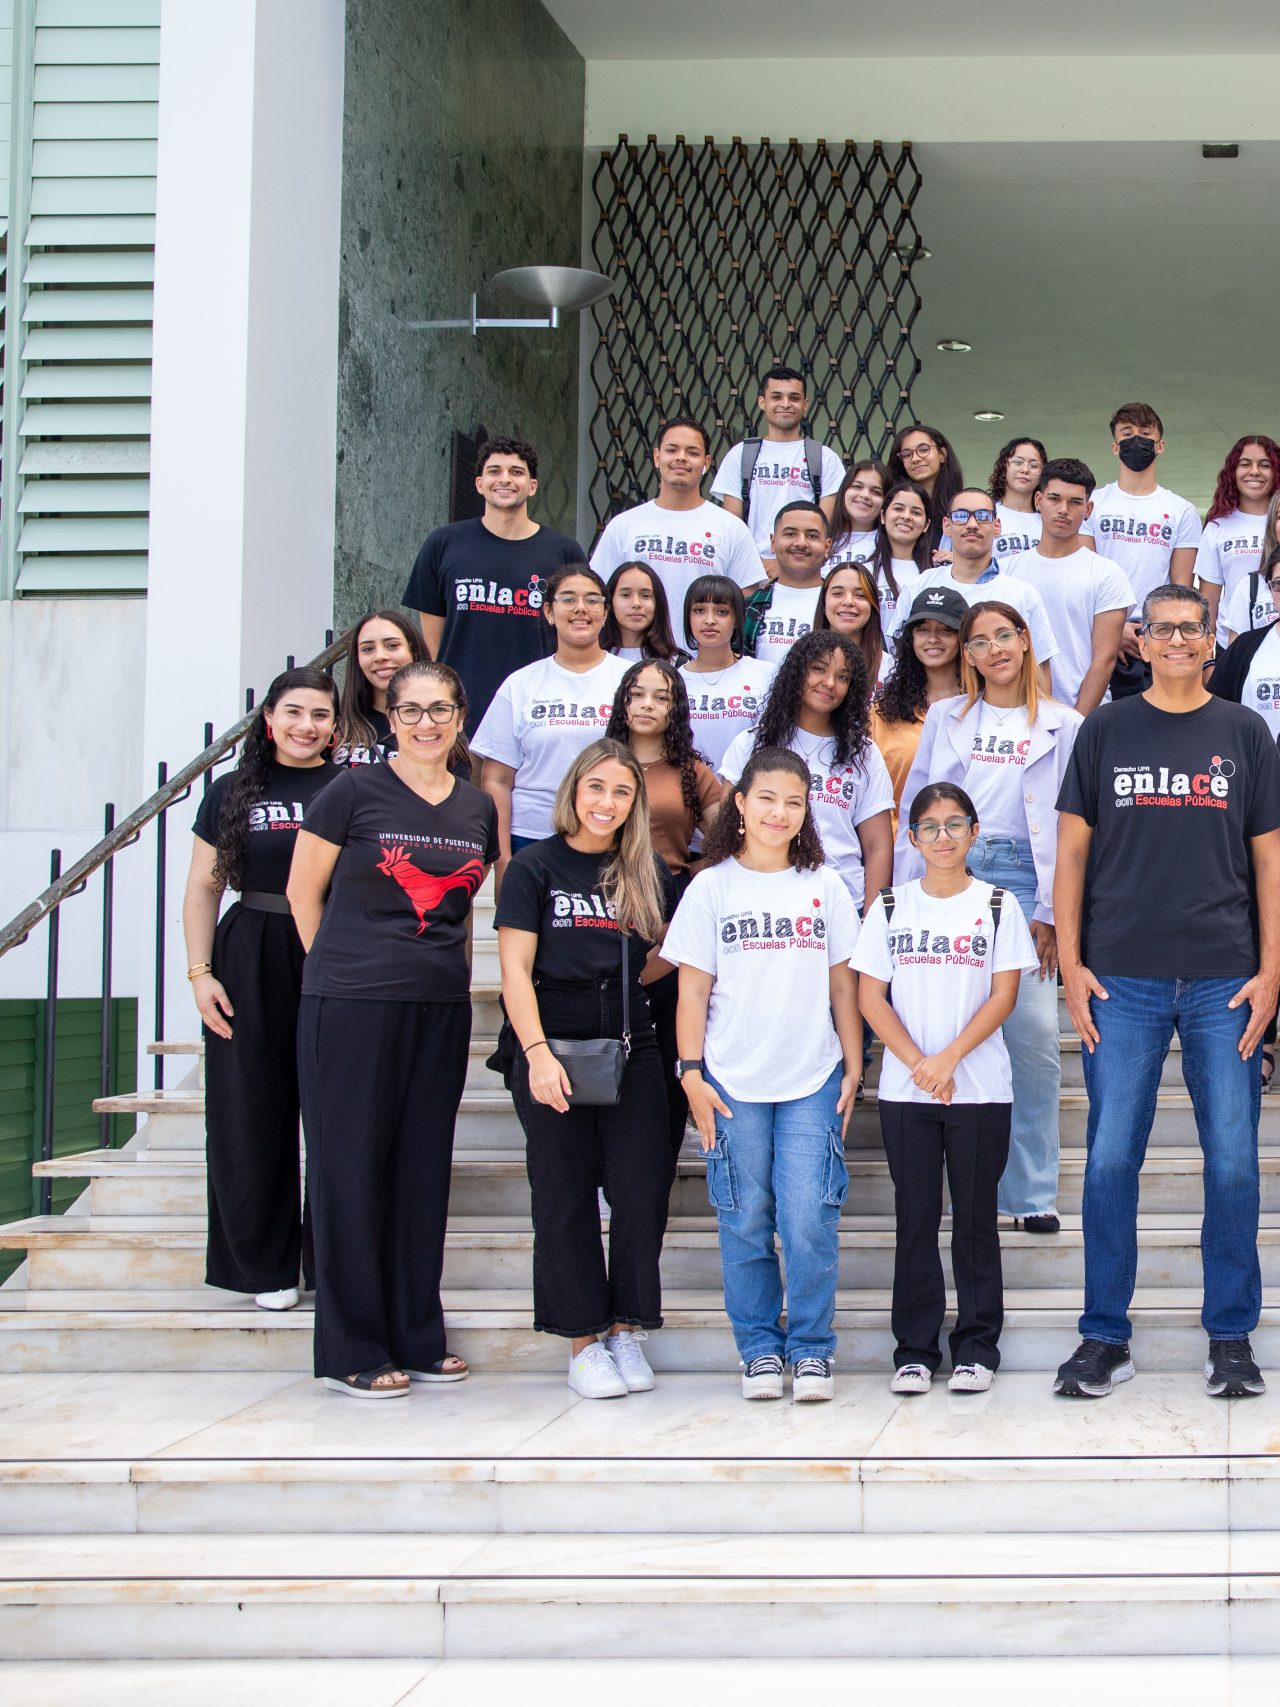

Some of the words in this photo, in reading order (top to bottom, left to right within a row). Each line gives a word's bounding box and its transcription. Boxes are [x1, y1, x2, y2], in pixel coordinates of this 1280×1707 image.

[1100, 518, 1172, 540] enlace
[634, 536, 716, 558] enlace
[648, 552, 682, 564] Escuelas
[684, 555, 714, 567] Públicas
[456, 580, 542, 608] enlace
[470, 602, 505, 614] Escuelas
[549, 718, 590, 726] Escuelas
[1114, 767, 1228, 798] enlace
[1115, 796, 1133, 808] con
[1136, 794, 1182, 806] Escuelas
[1184, 794, 1228, 810] Públicas
[380, 832, 430, 842] UNIVERSIDAD
[434, 836, 442, 844] DE
[446, 838, 470, 848] PUERTO
[472, 842, 483, 851] RICO
[574, 916, 619, 929] Escuelas
[721, 912, 826, 944] enlace
[742, 940, 786, 950] Escuelas
[790, 938, 826, 950] Públicas
[899, 954, 942, 966] Escuelas
[946, 954, 984, 968] Públicas
